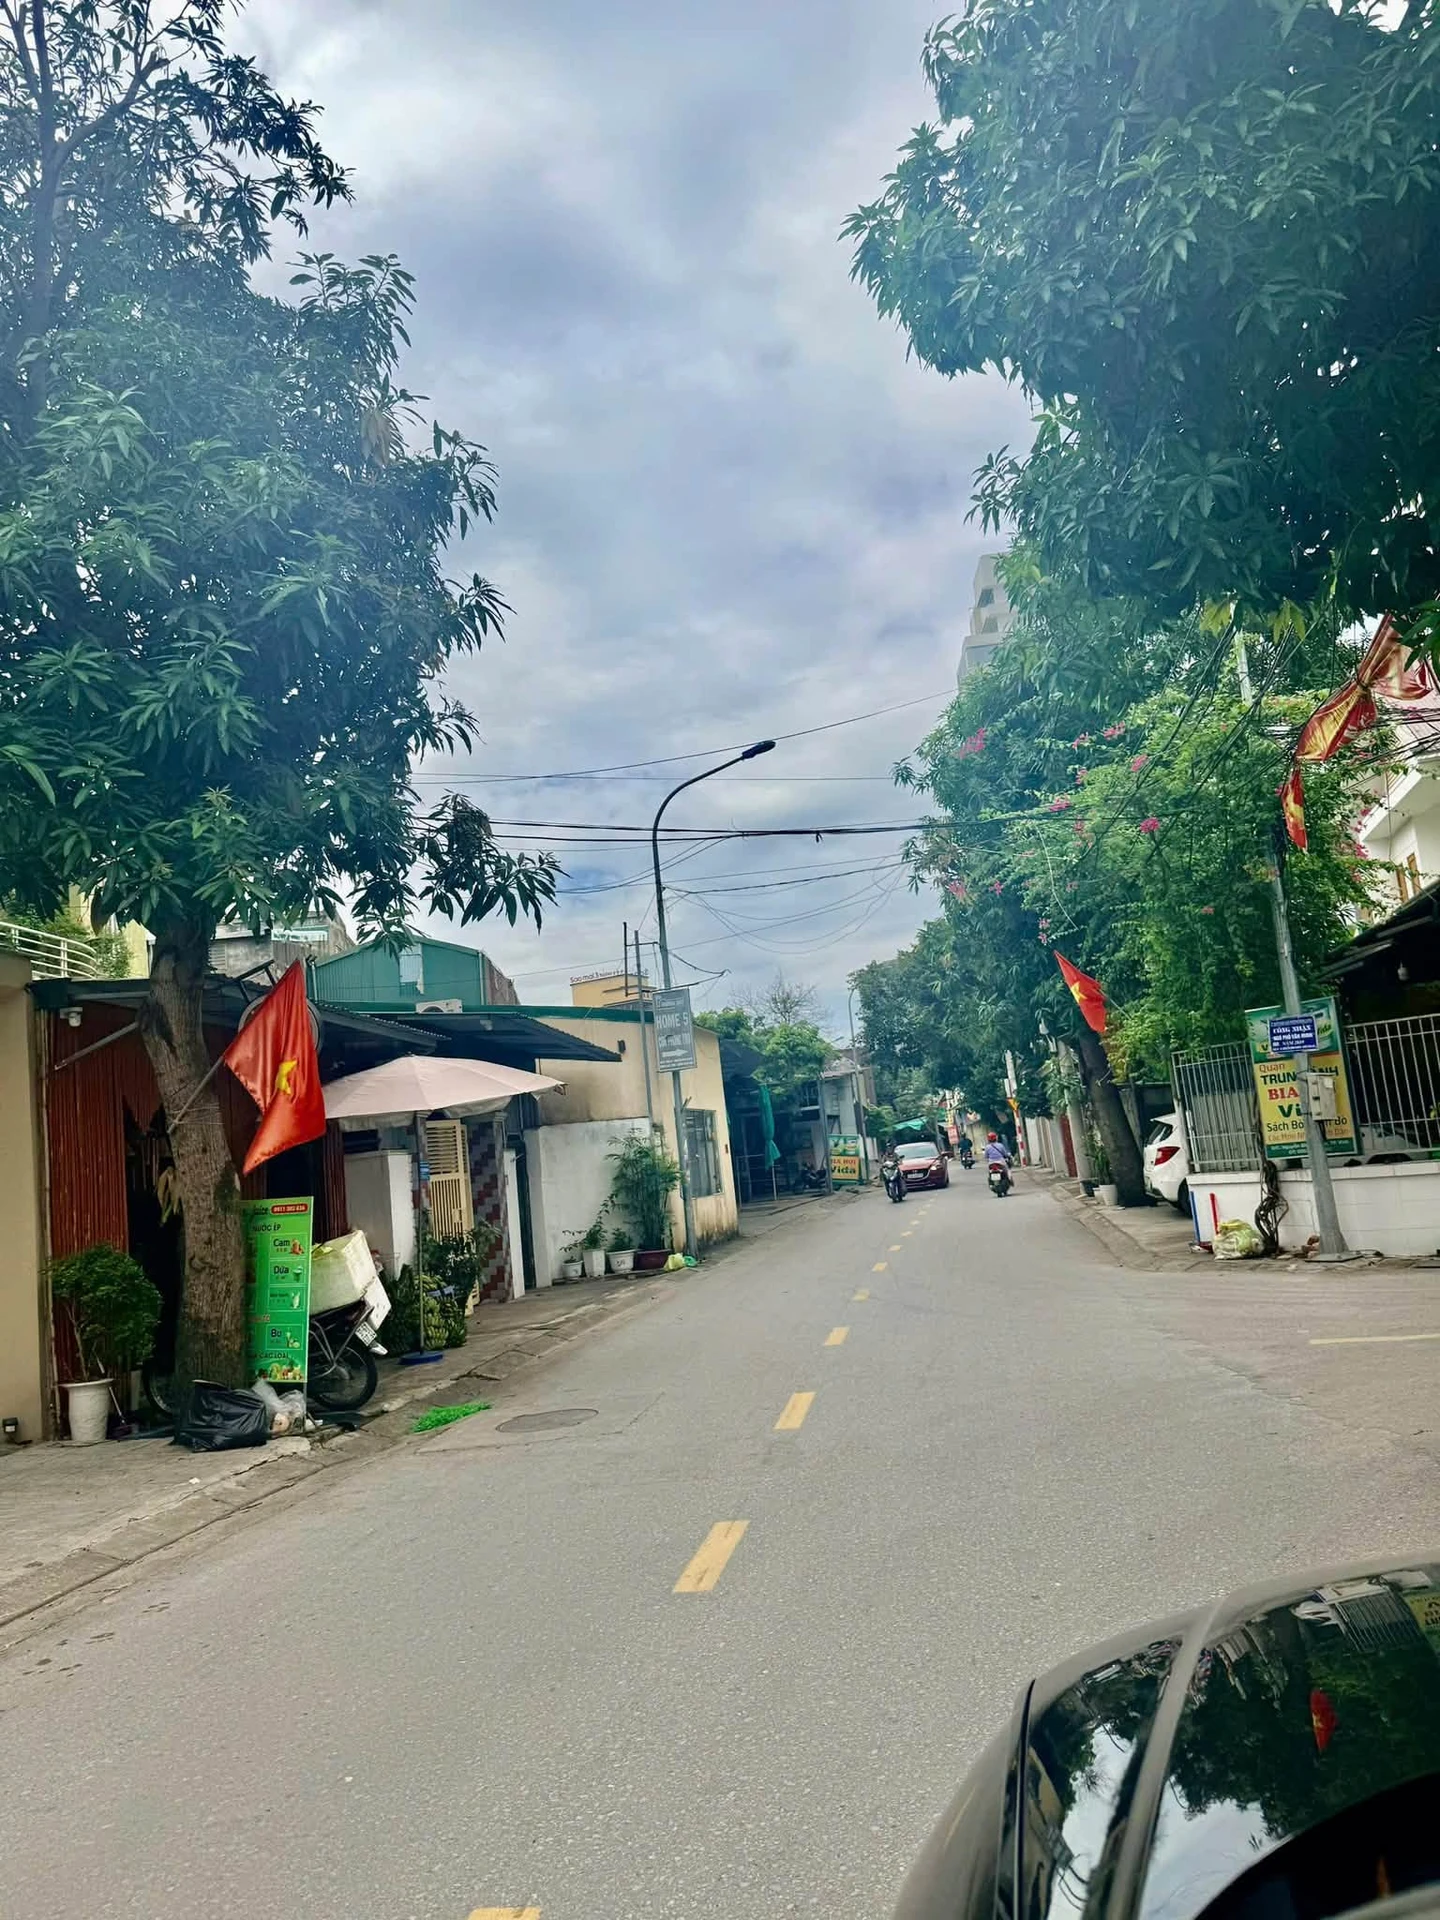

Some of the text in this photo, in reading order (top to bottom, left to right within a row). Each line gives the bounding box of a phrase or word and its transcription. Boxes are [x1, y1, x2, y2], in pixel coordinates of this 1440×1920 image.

[1261, 1071, 1298, 1085] TRUN
[1268, 1086, 1300, 1100] BIA
[273, 1239, 290, 1247] Cam
